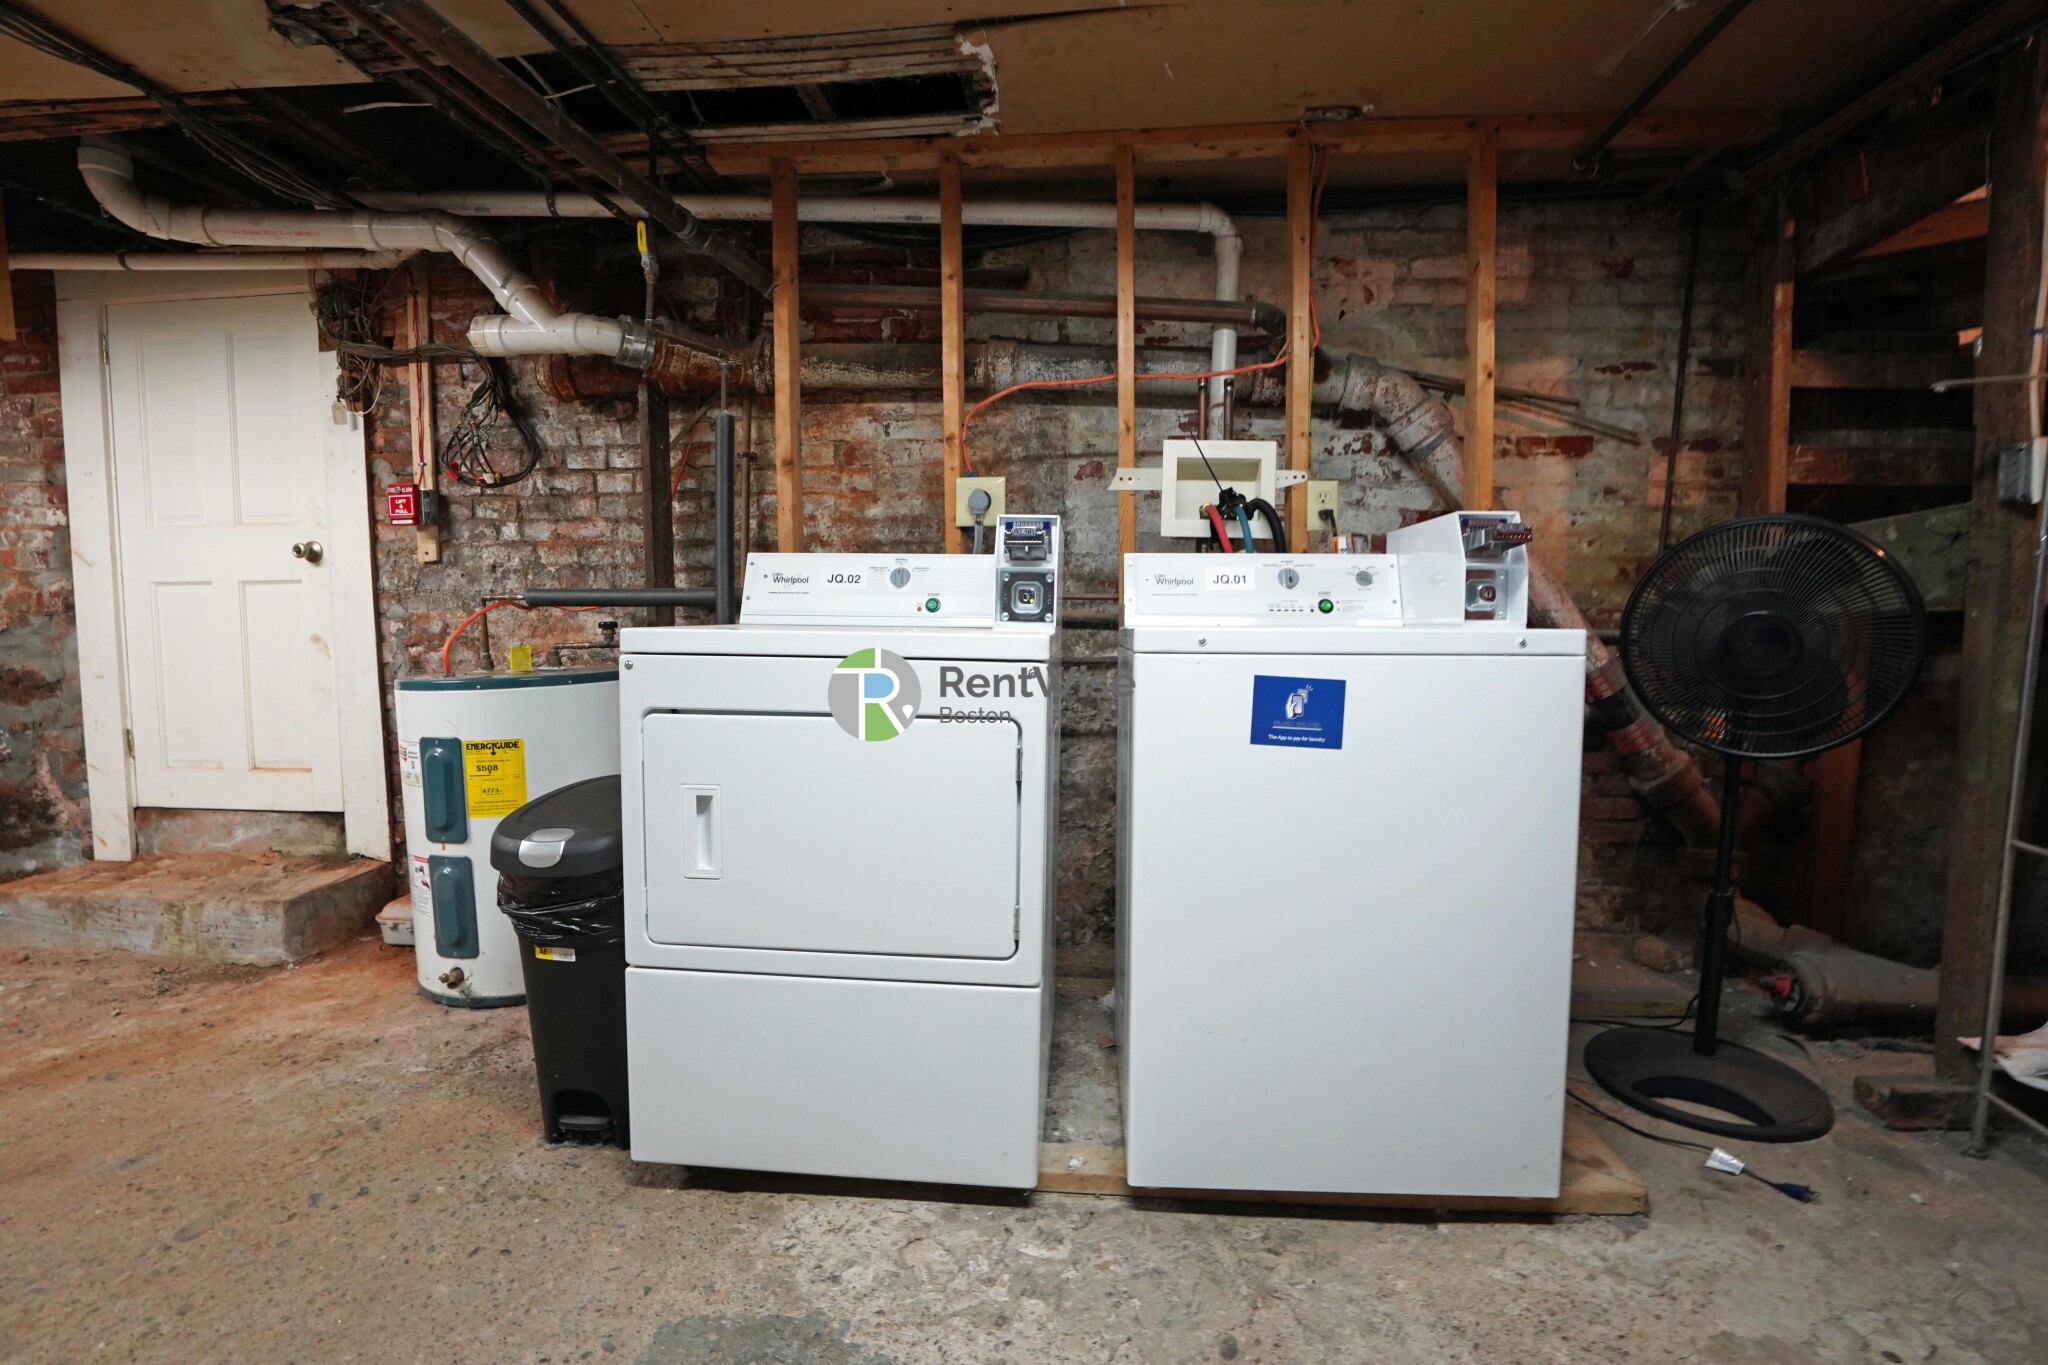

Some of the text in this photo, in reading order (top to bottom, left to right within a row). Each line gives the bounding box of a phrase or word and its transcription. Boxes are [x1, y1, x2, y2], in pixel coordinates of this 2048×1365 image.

[772, 575, 809, 585] Whirlpool
[827, 574, 861, 584] JQ.02
[1155, 577, 1194, 586] Whirlpool
[1213, 574, 1247, 584] JQ.01
[466, 741, 520, 750] ENERGYGUIDE
